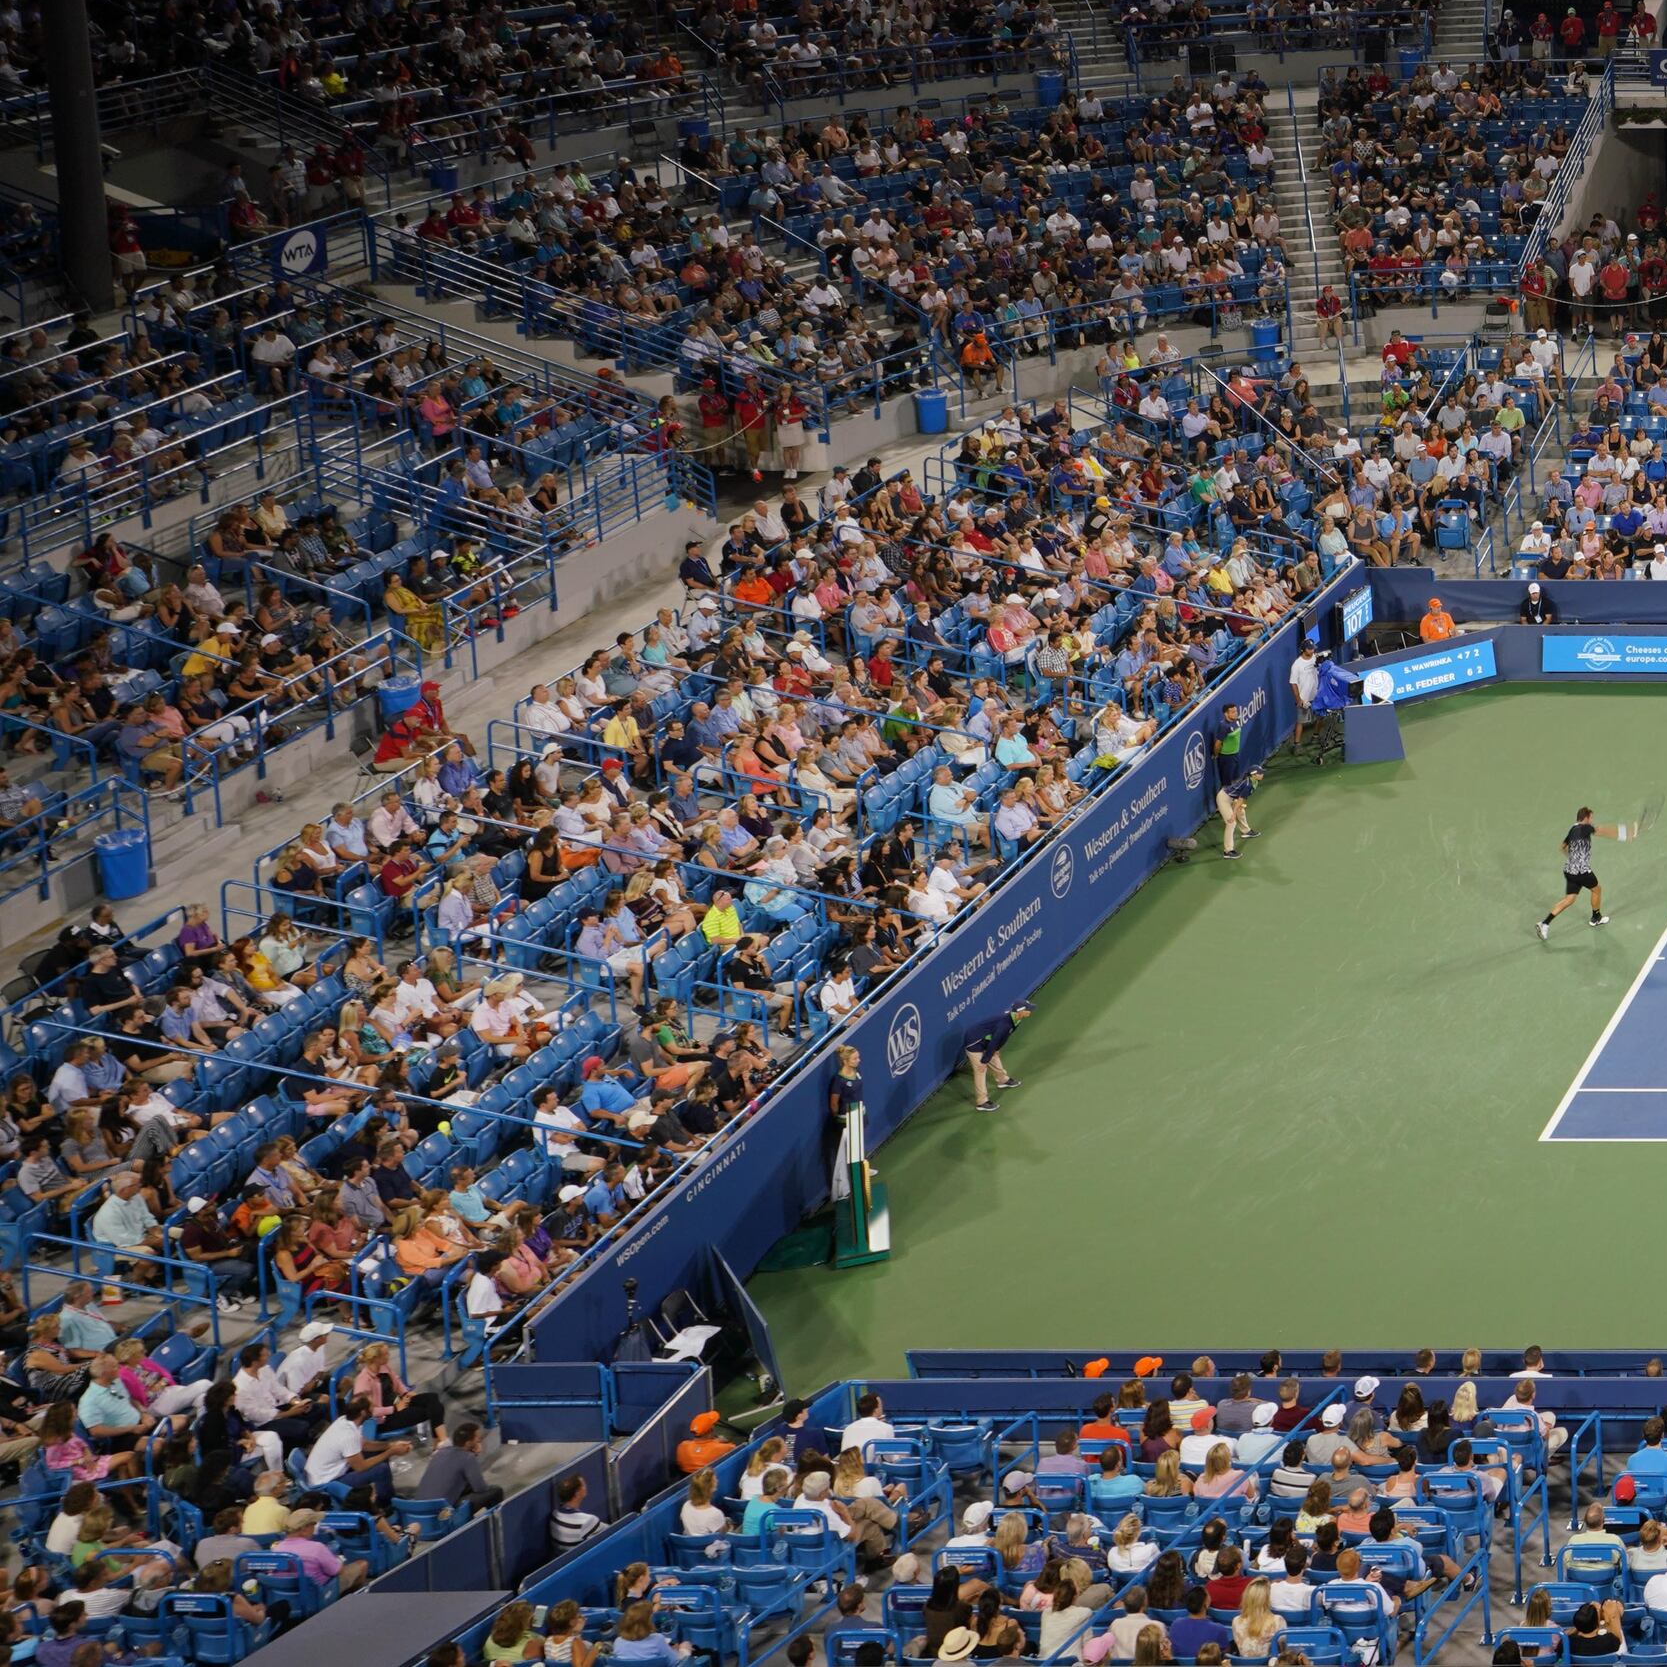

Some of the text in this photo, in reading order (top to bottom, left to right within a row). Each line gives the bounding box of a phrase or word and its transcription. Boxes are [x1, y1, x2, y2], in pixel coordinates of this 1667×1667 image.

[284, 244, 314, 262] WTA
[1347, 609, 1362, 636] 107
[1625, 645, 1661, 654] Cheeses
[1412, 656, 1453, 672] WAWRINKA
[1406, 684, 1414, 692] R.
[1416, 673, 1456, 690] FEDERER
[1084, 776, 1168, 862] Western & Southern
[941, 897, 1042, 998] Western & Southern
[686, 1141, 746, 1202] CINCINNATI
[616, 1215, 670, 1267] WSOpen.com
